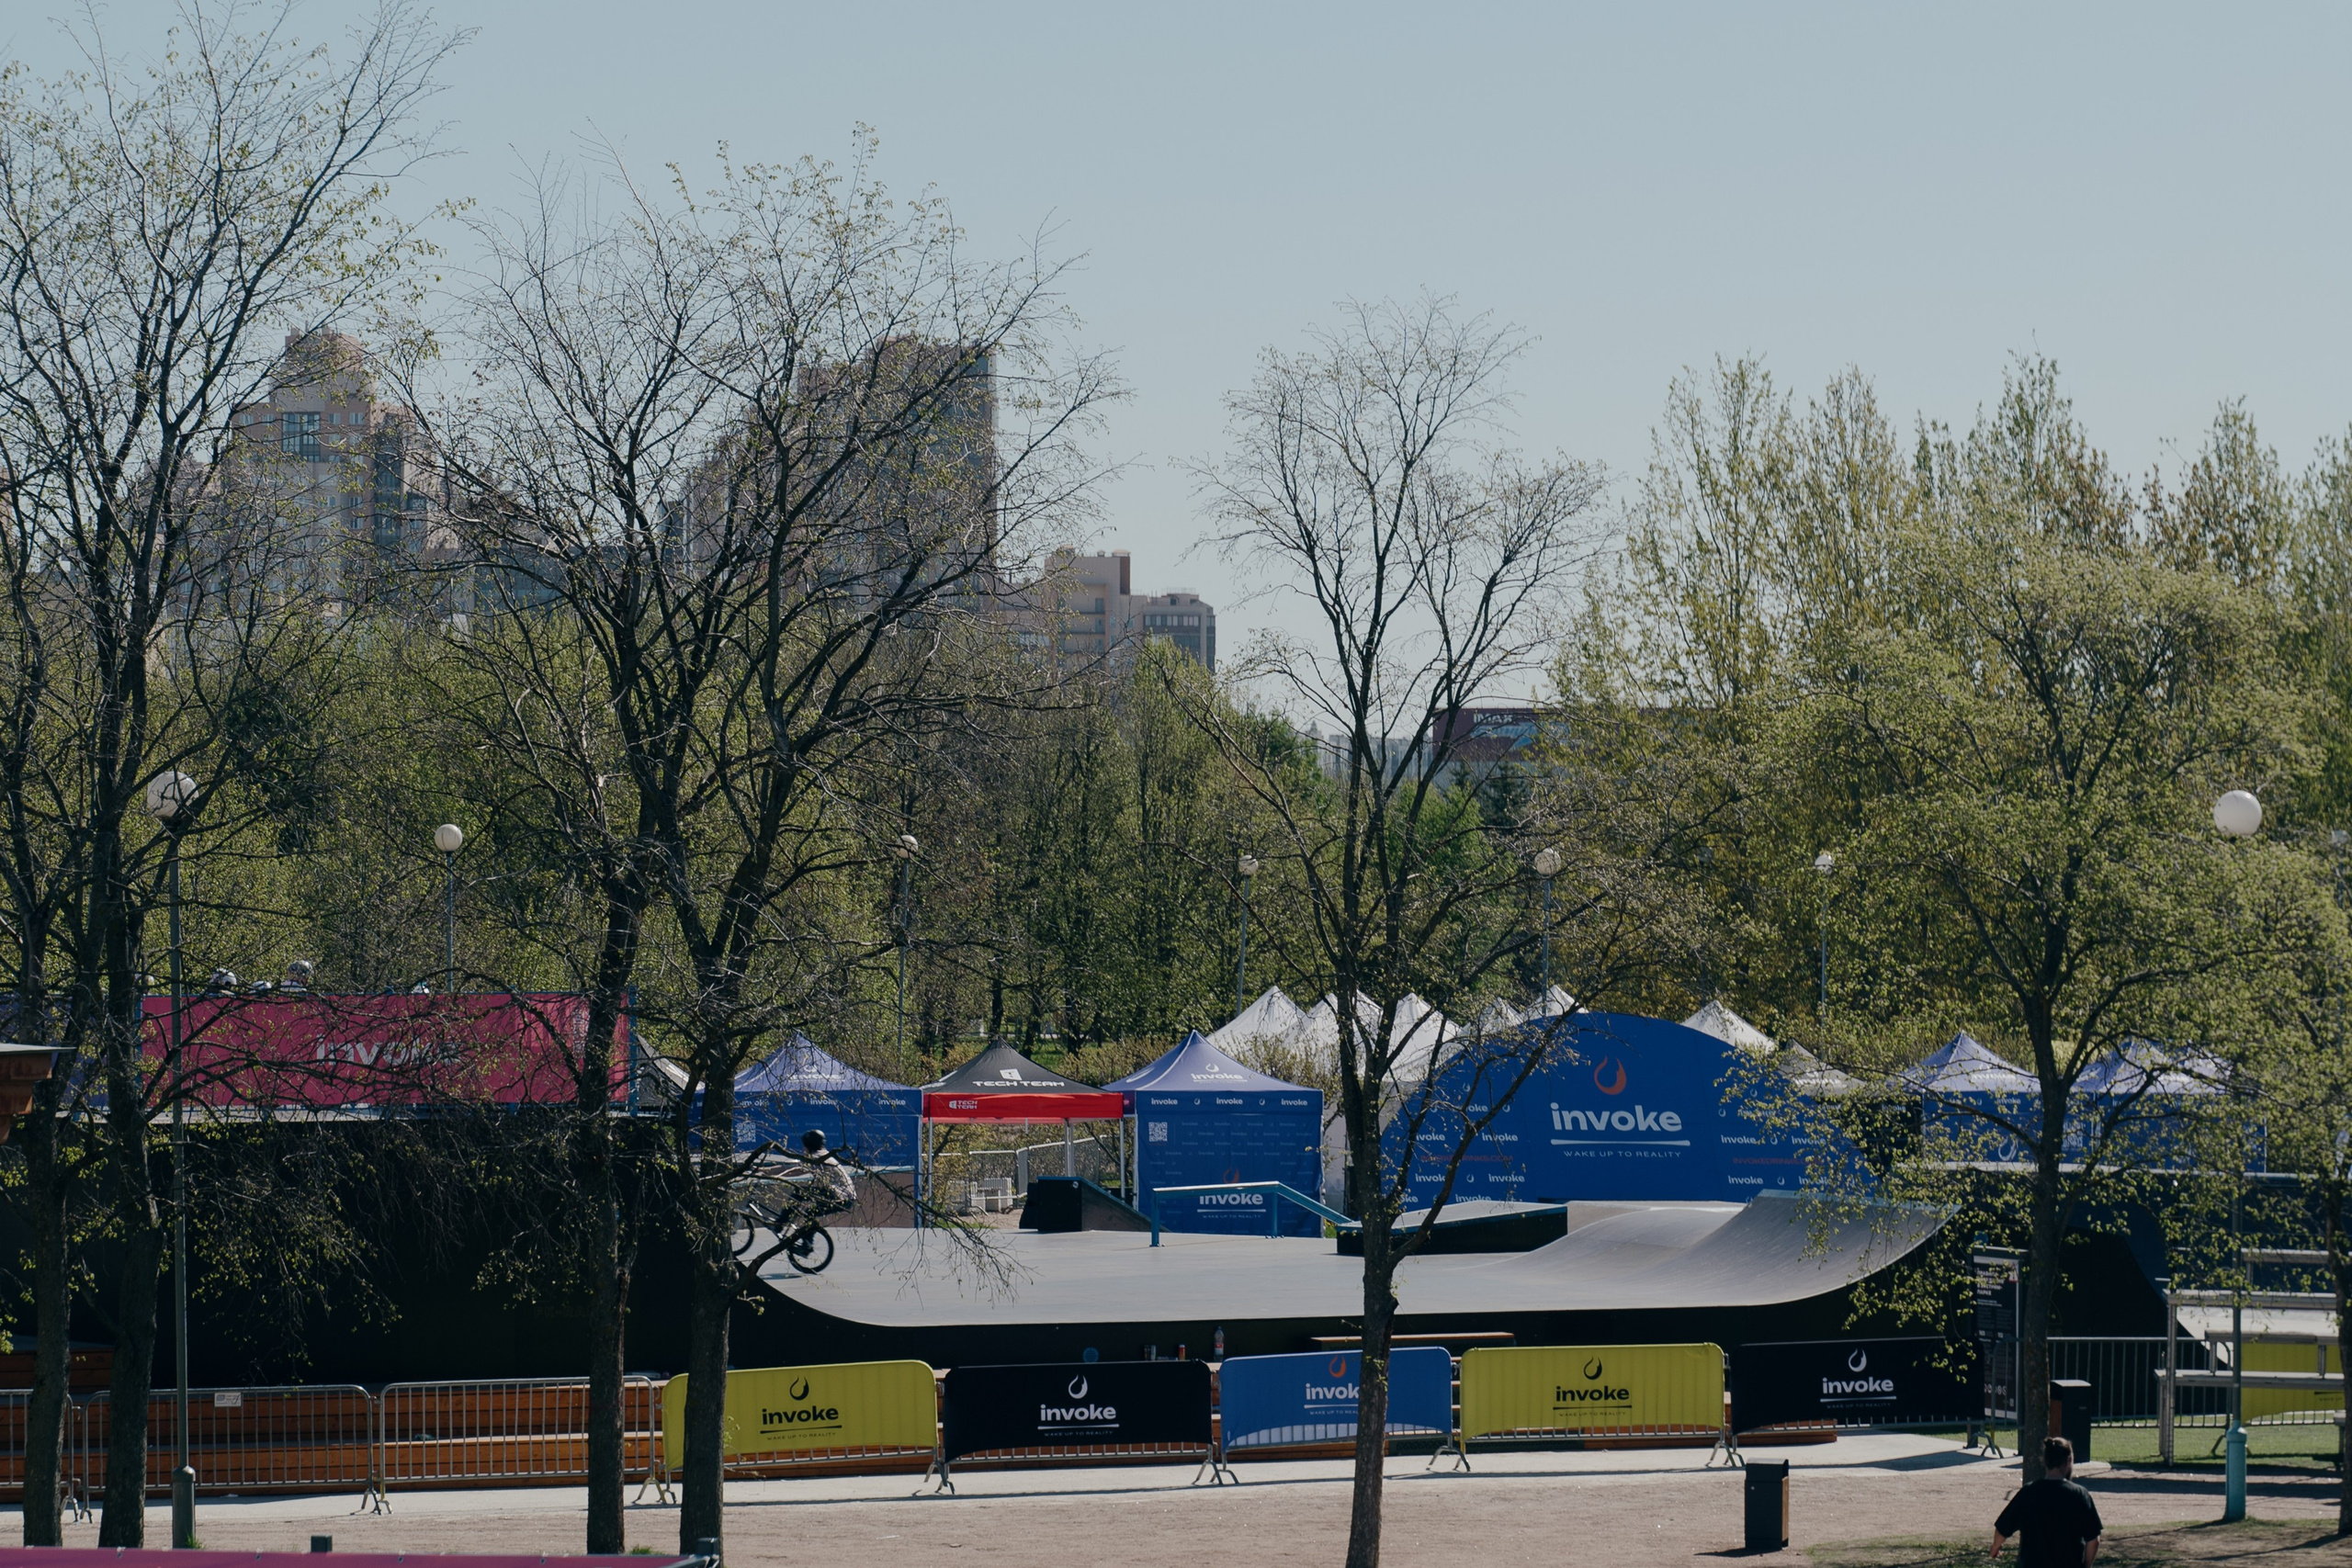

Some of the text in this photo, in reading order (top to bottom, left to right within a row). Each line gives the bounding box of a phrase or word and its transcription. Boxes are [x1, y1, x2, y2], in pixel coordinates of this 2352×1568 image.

[1151, 1097, 1178, 1105] invoke
[1216, 1097, 1243, 1105] invoke
[1281, 1098, 1308, 1106] invoke
[1550, 1102, 1682, 1132] invoke
[1481, 1132, 1518, 1142] invoke
[1721, 1134, 1757, 1145] invoke
[1564, 1150, 1681, 1158] WAKE UP TO REALITY
[1415, 1173, 1446, 1182] invok
[1488, 1174, 1526, 1183] invoke
[1728, 1175, 1764, 1185] invoke
[1199, 1192, 1264, 1205] invoke
[1822, 1376, 1894, 1394] invoke
[1306, 1382, 1360, 1400] invok
[1555, 1385, 1630, 1402] invoke
[762, 1405, 839, 1425] invoke
[1040, 1404, 1116, 1421] invoke
